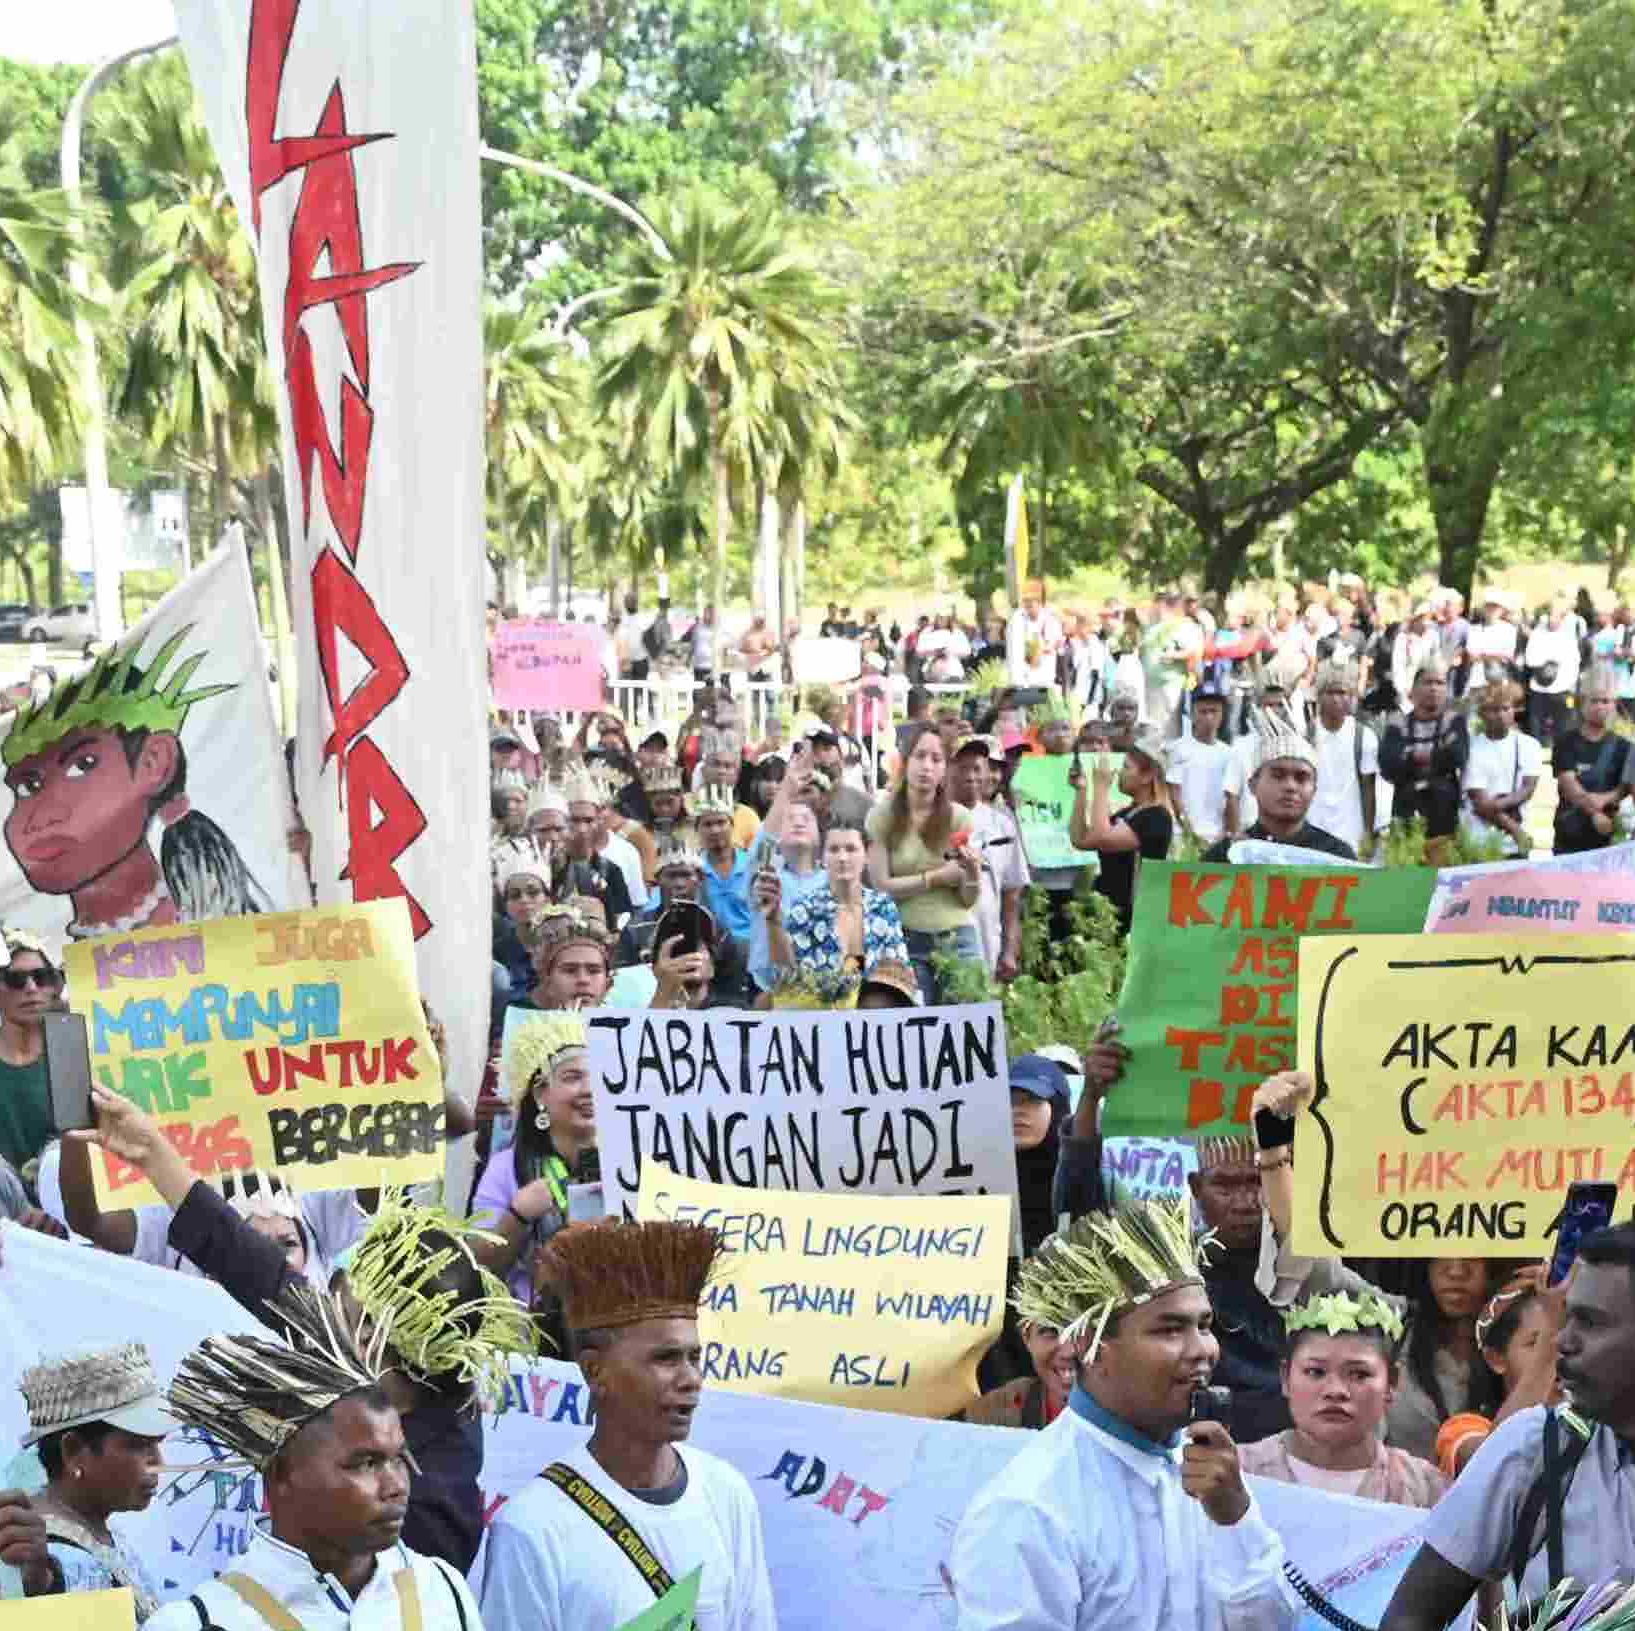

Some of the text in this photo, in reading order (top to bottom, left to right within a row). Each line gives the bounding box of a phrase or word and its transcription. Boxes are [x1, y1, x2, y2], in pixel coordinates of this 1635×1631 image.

[1166, 872, 1360, 930] KAMI
[1227, 939, 1297, 976] AS
[1221, 983, 1293, 1026] DI
[245, 1037, 420, 1095] UNTUK
[591, 1014, 997, 1097] JABATAN HUTAN
[1166, 1028, 1297, 1074] TAS
[1381, 1023, 1520, 1068] AKTA
[615, 1100, 974, 1192] JANGAN JADI
[1377, 1151, 1464, 1193] HAK
[802, 1223, 984, 1257] LINGDUNGI
[1380, 1203, 1526, 1241] ORANG
[766, 1282, 853, 1315] TANAH
[876, 1289, 992, 1327] WILAYAH
[702, 1345, 909, 1388] RANG ASLI
[494, 1372, 592, 1425] AYA
